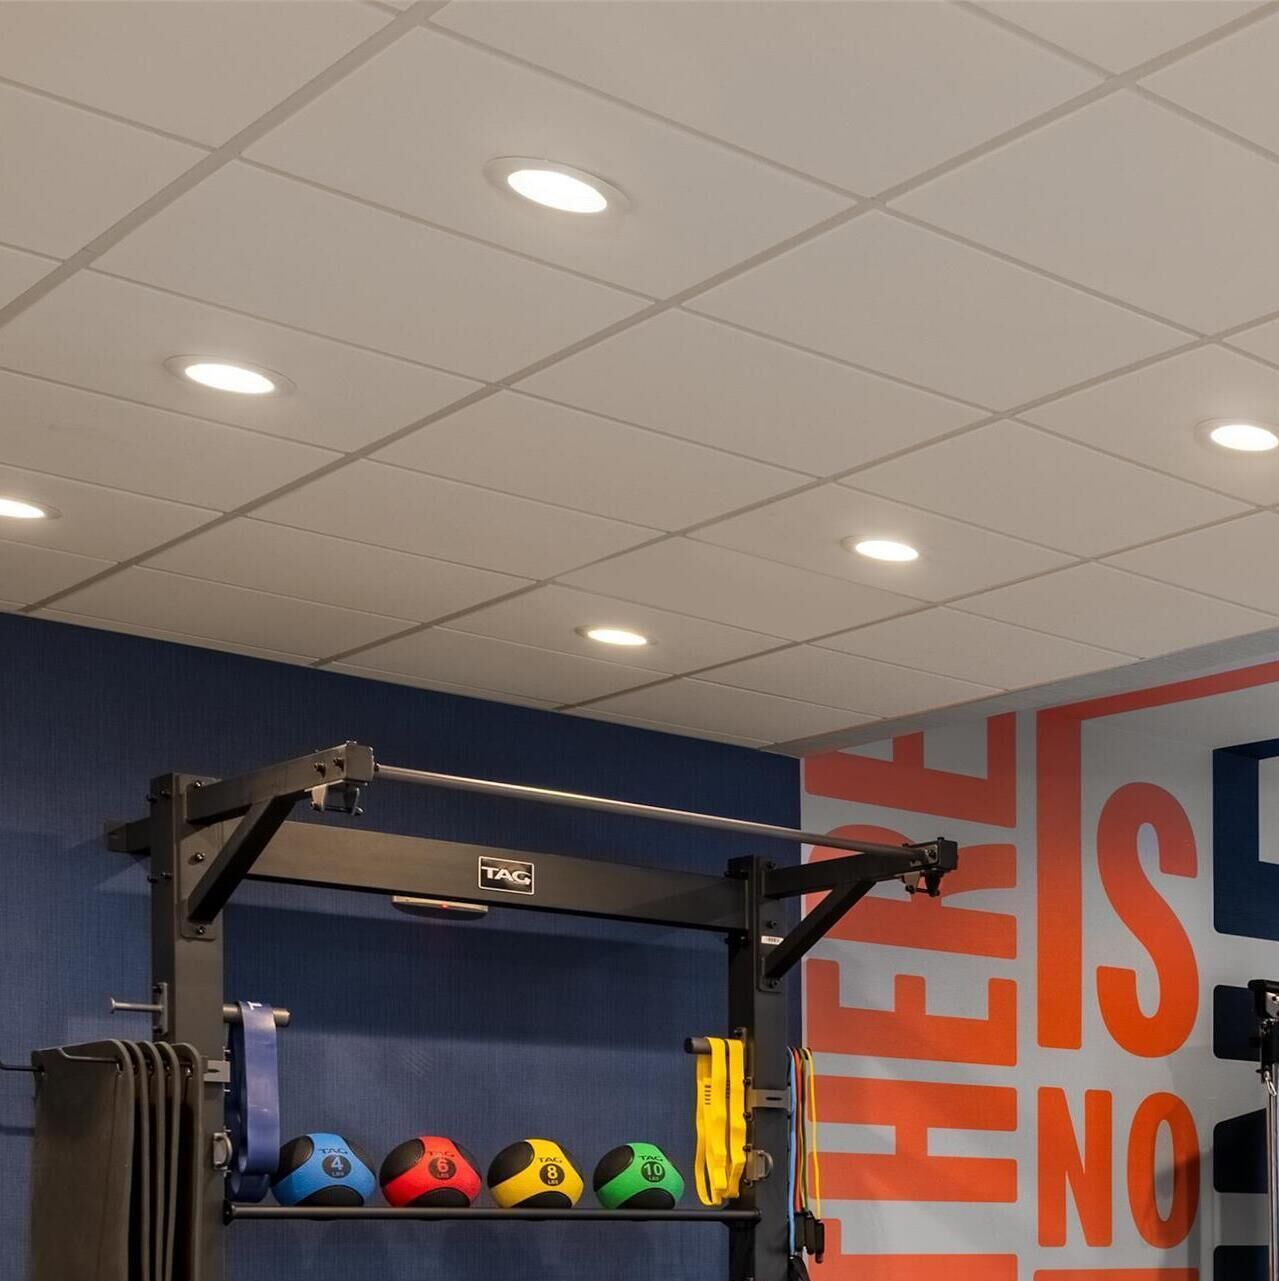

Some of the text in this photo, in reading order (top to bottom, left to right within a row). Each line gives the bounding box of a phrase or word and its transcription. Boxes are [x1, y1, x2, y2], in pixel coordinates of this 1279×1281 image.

[481, 866, 531, 885] TAG
[1036, 706, 1199, 1058] IS
[330, 1157, 344, 1171] 4
[436, 1159, 448, 1173] 6
[546, 1164, 558, 1179] 8
[643, 1163, 663, 1177] 10
[1037, 1085, 1199, 1249] NO
